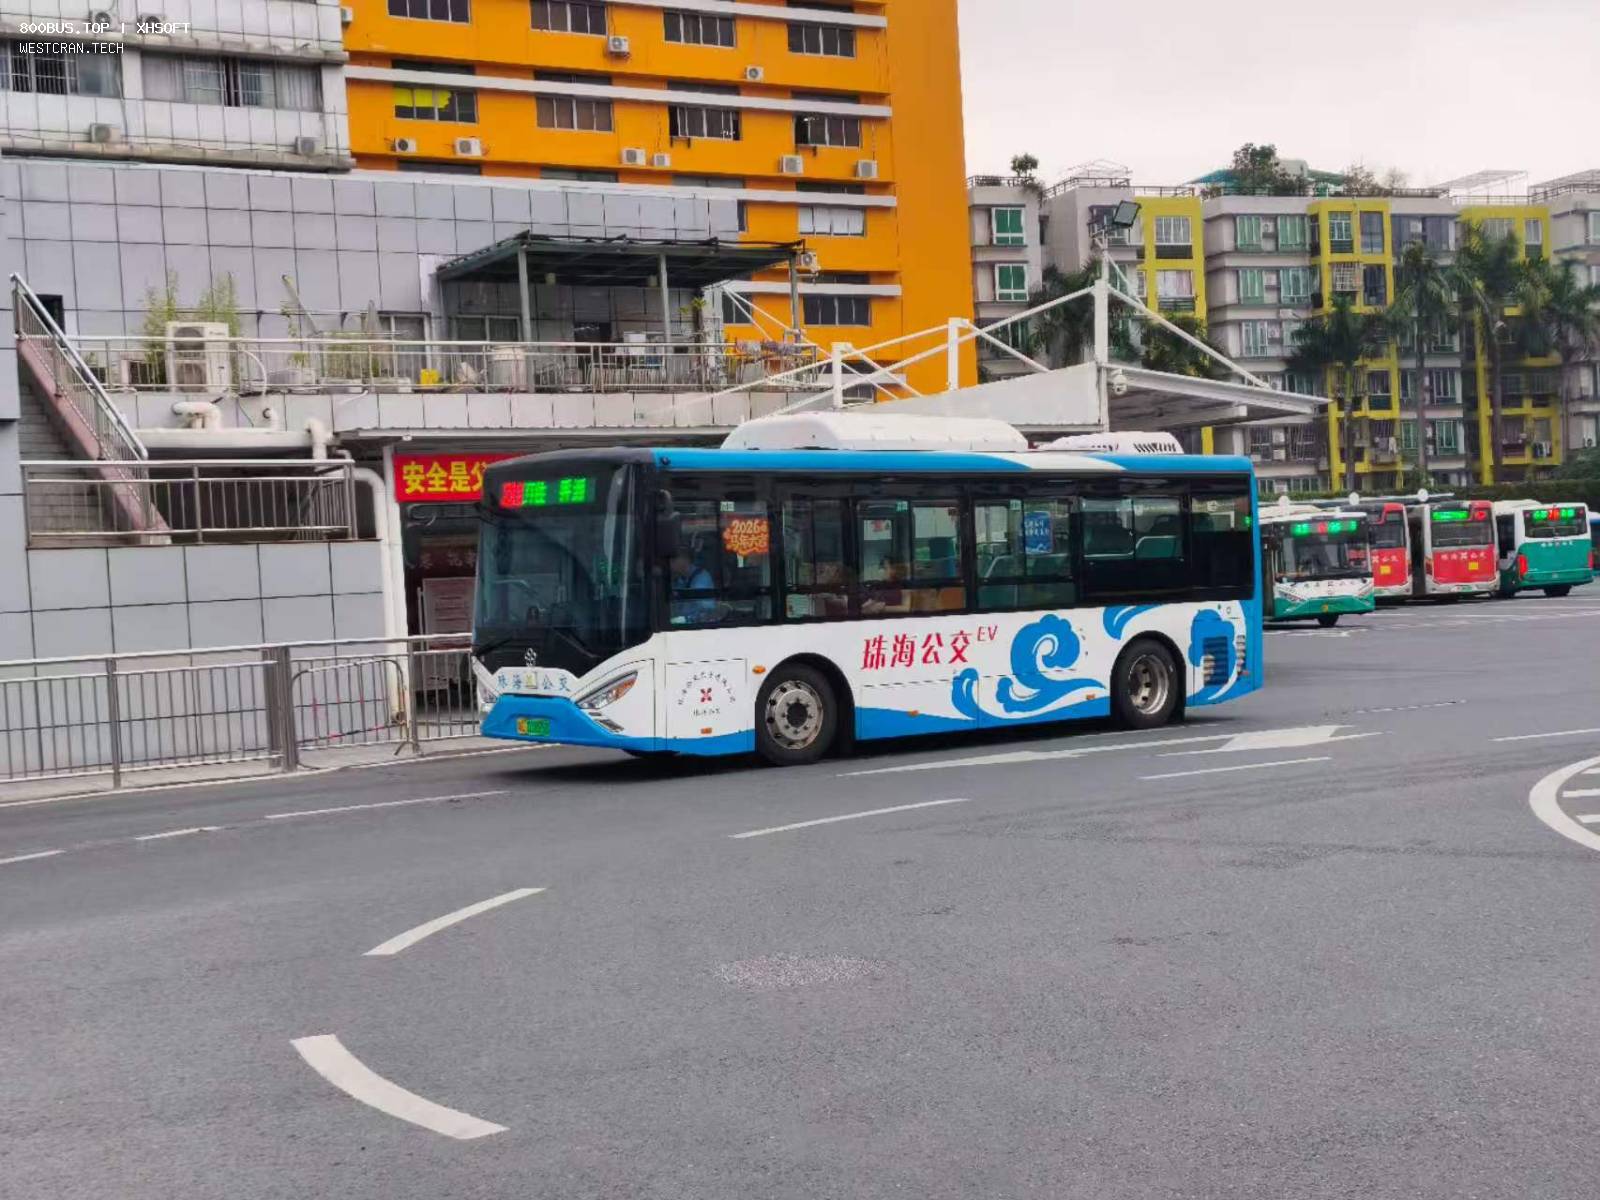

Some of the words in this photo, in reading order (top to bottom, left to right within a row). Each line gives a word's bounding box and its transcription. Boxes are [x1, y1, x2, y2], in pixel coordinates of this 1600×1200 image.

[860, 630, 972, 671] 珠海公交
[976, 624, 998, 642] EV
